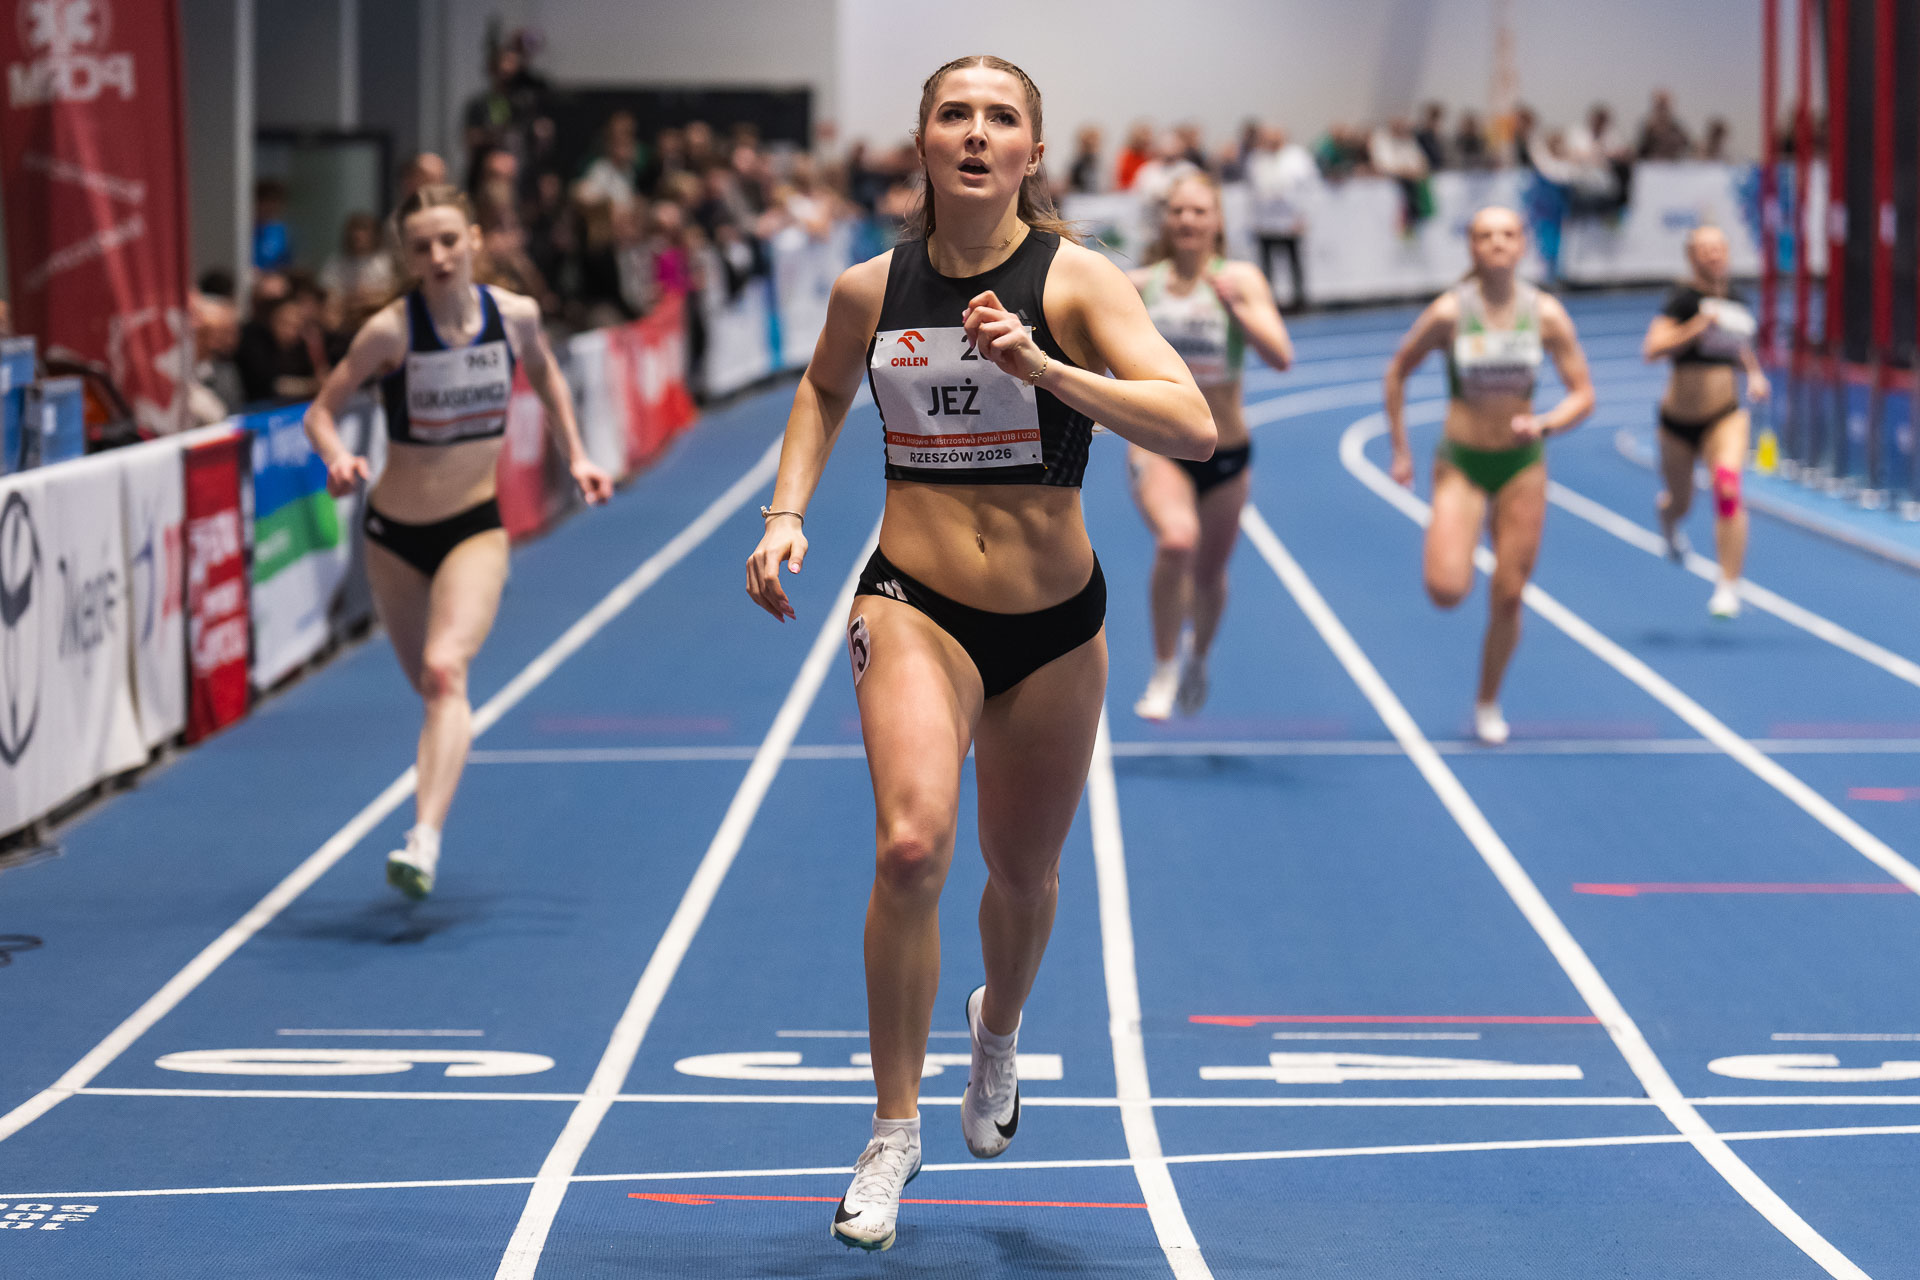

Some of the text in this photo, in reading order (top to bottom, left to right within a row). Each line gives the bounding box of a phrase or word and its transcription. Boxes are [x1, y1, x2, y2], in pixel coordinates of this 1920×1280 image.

[891, 356, 929, 367] ORLEN
[927, 377, 981, 417] JEŻ
[892, 434, 905, 443] PZLA
[906, 436, 928, 445] Halowe
[930, 436, 976, 445] Mistrzostwa
[977, 434, 1000, 443] Polski
[1002, 433, 1016, 441] U18
[1021, 431, 1037, 440] U20
[909, 447, 1012, 464] RZESZÓW 2026
[850, 620, 867, 672] 5
[155, 1049, 555, 1077] 6
[1199, 1052, 1584, 1084] 4
